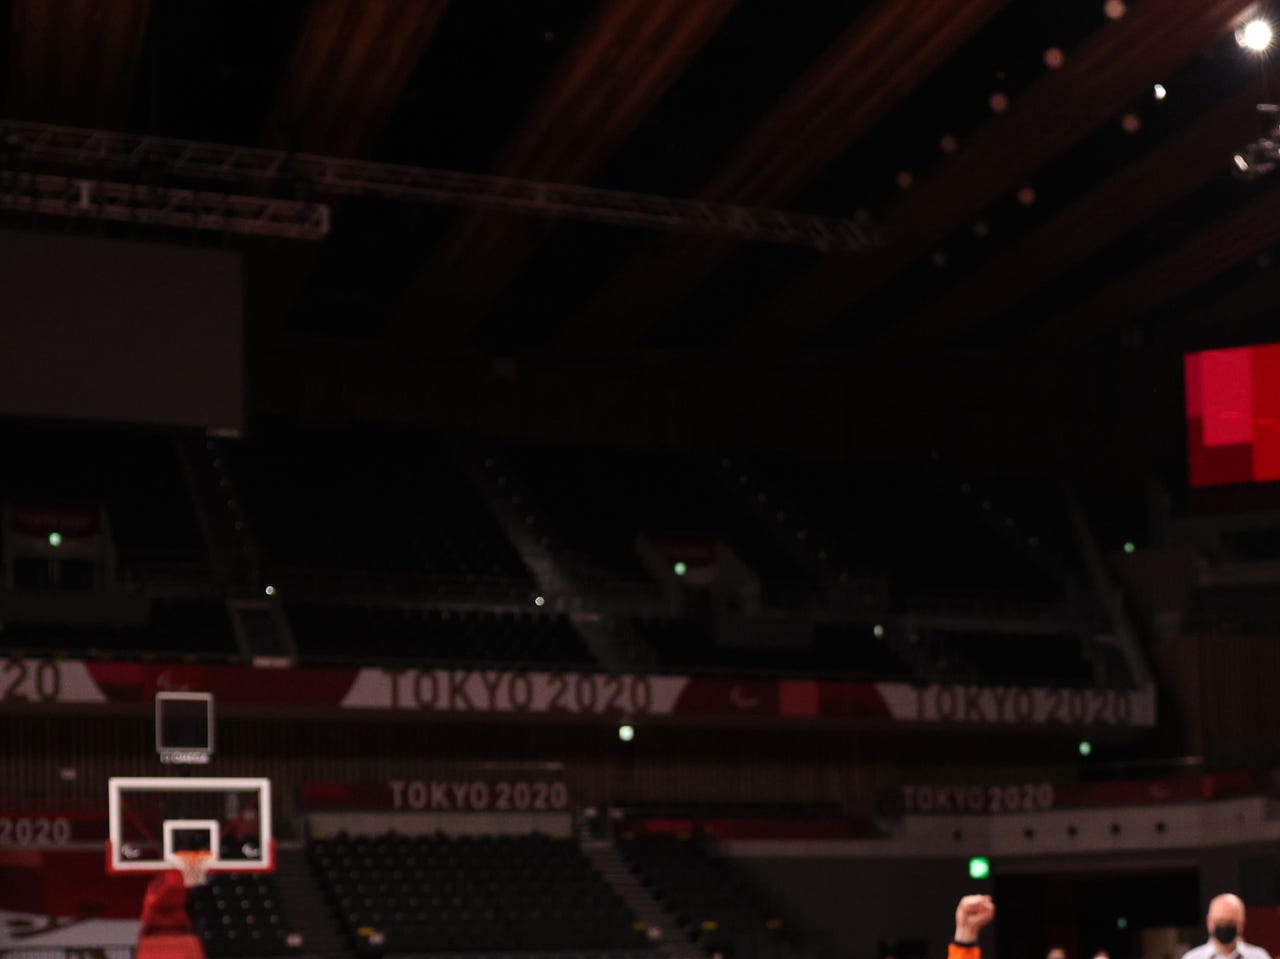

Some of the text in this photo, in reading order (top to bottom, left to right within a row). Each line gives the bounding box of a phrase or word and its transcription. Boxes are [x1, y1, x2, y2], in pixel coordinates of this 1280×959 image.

[383, 667, 654, 714] TOKYO 2020
[911, 683, 1132, 726] TOKYO 2020
[388, 780, 569, 811] TOKYO 2020
[903, 782, 1055, 813] TOKYO 2020
[0, 816, 71, 845] 2020
